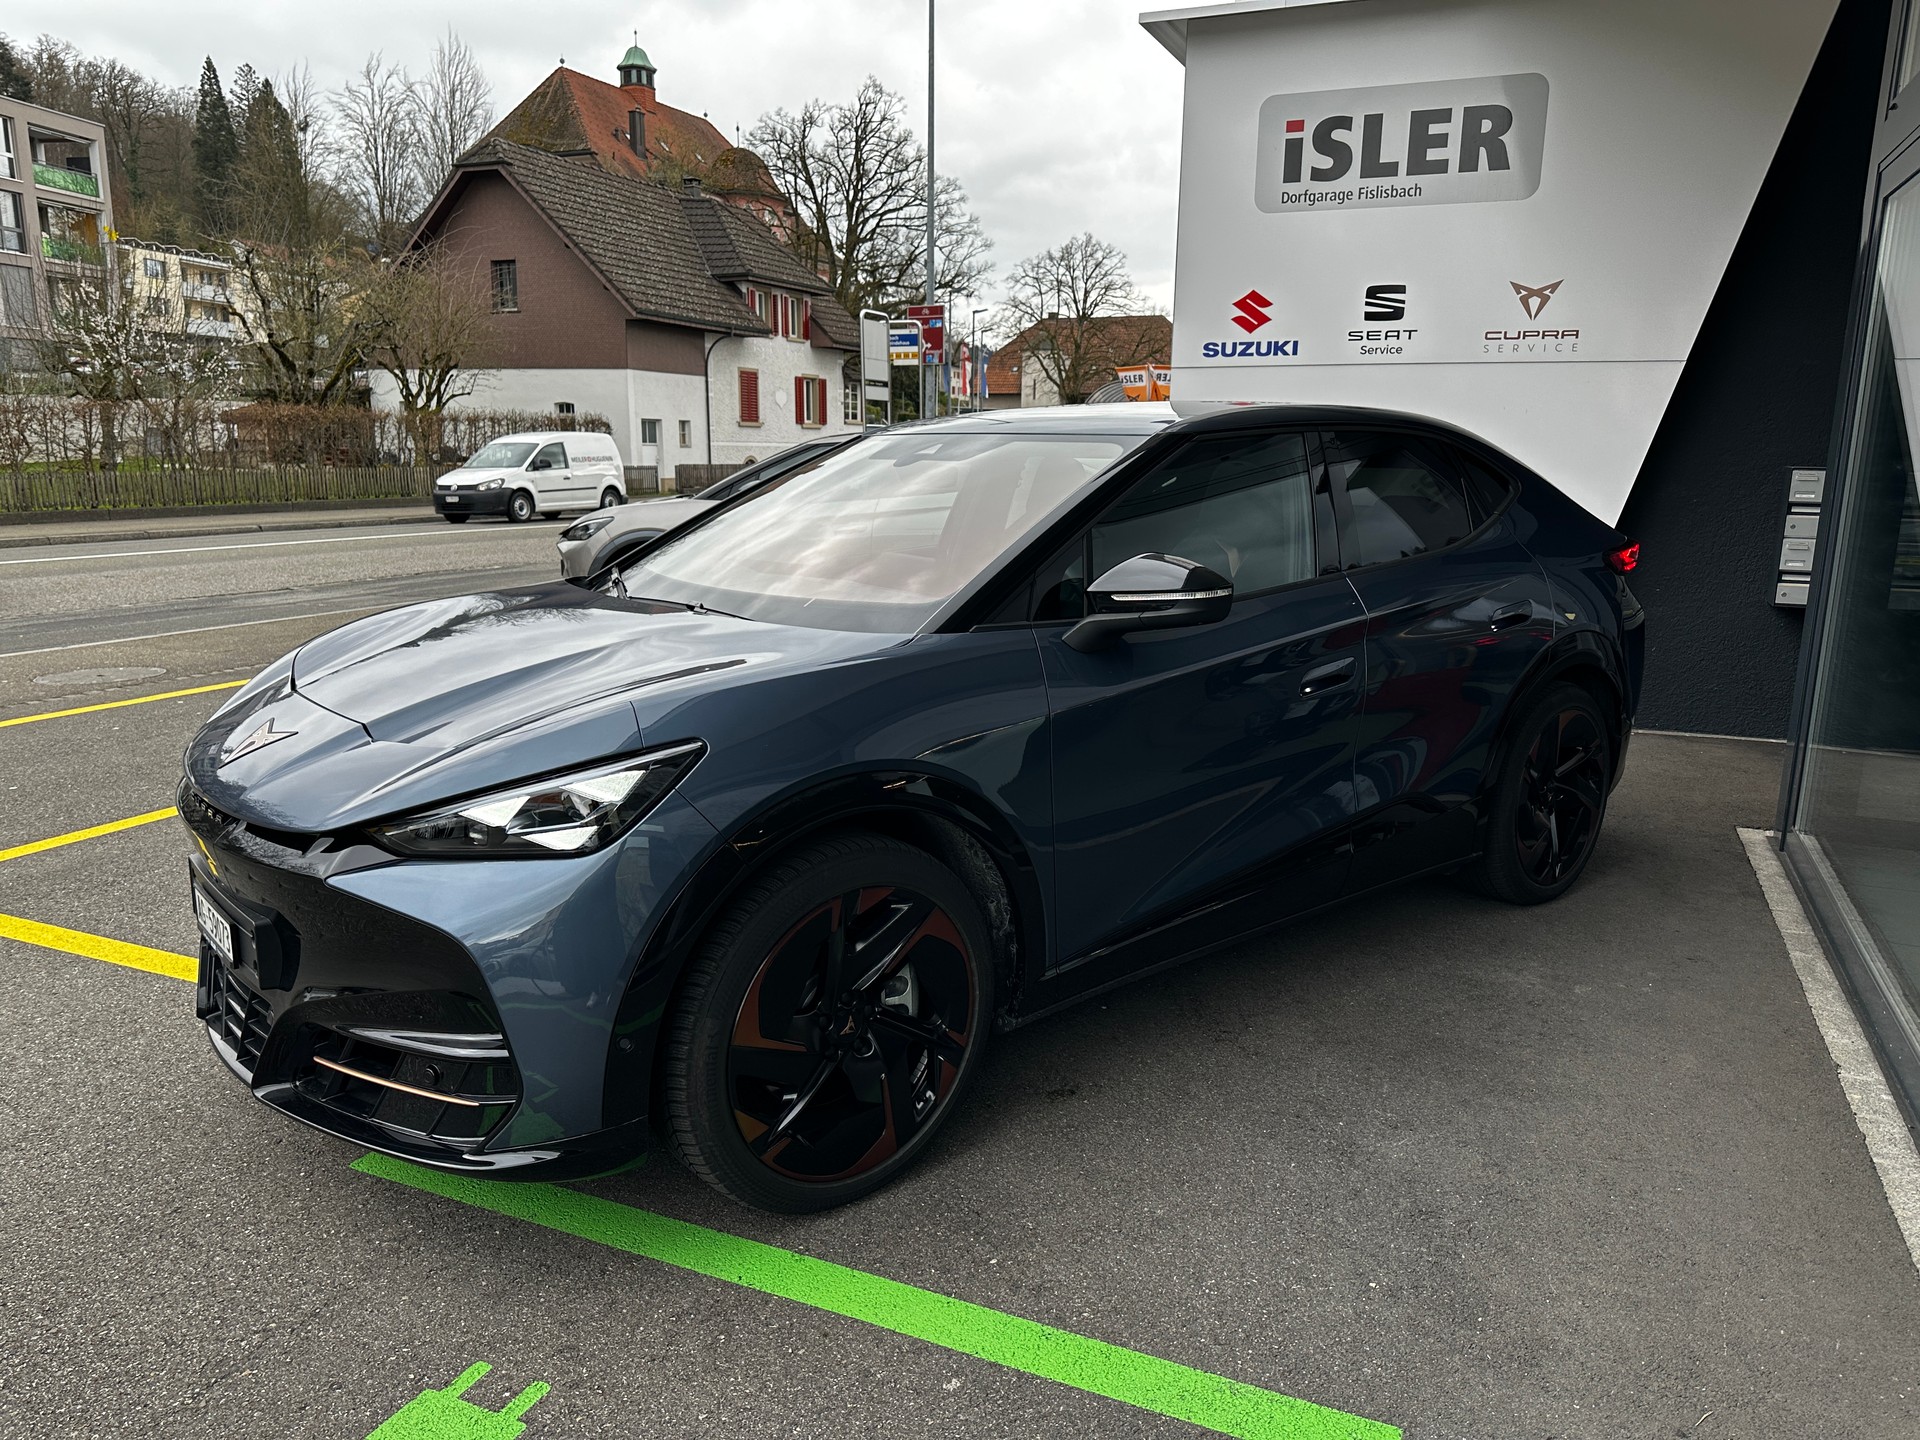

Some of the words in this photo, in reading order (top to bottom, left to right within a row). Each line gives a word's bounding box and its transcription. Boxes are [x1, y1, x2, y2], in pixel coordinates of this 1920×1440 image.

[1282, 104, 1514, 184] iSLER
[1281, 189, 1354, 207] Dorfgarage
[1358, 183, 1422, 200] Fislisbach
[1347, 329, 1418, 342] SEAT
[1484, 329, 1580, 341] CUPRA
[1202, 340, 1299, 358] SUZUKI
[1359, 344, 1403, 355] Service
[1483, 343, 1578, 353] SERVICE
